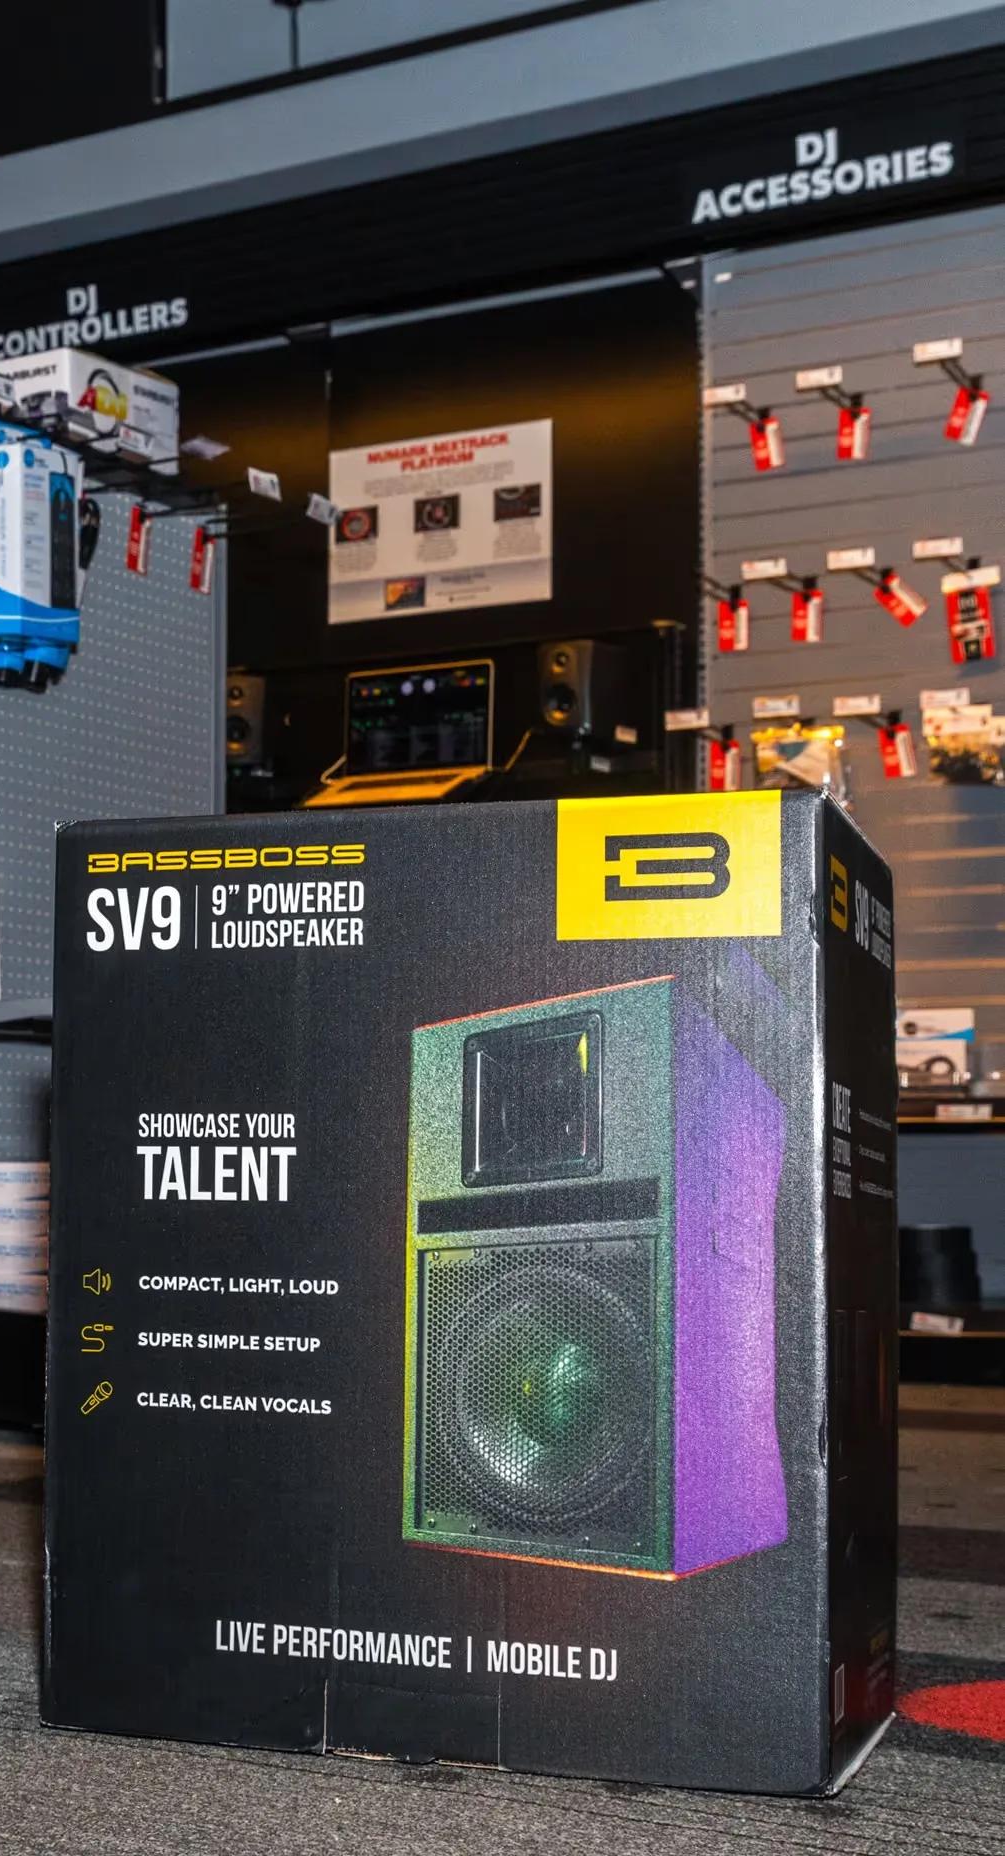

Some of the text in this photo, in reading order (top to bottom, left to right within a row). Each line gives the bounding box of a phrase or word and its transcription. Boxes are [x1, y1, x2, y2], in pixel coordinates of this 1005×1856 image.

[795, 127, 838, 167] DJ
[691, 141, 954, 224] ACCESSORIES
[66, 283, 99, 317] DJ
[367, 432, 508, 464] NUMARK MIXTRACK
[401, 450, 474, 471] PLATINUM
[88, 844, 365, 873] BASSBOSS
[247, 881, 365, 914] POWERED
[86, 885, 181, 952] SV9
[211, 918, 364, 949] LOUDSPEAKER
[832, 1081, 851, 1134] CREATE
[138, 1113, 295, 1138] SHOWCASE YOUR
[136, 1145, 297, 1201] TALENT
[138, 1275, 339, 1296] COMPACT, LIGHT, LOUD
[137, 1332, 321, 1352] SUPER SIMPLE SETUP
[137, 1392, 332, 1414] CLEAR, CLEAN VOCALS
[215, 1619, 618, 1682] LIVE PERFORMANCE MOBILE DJ
